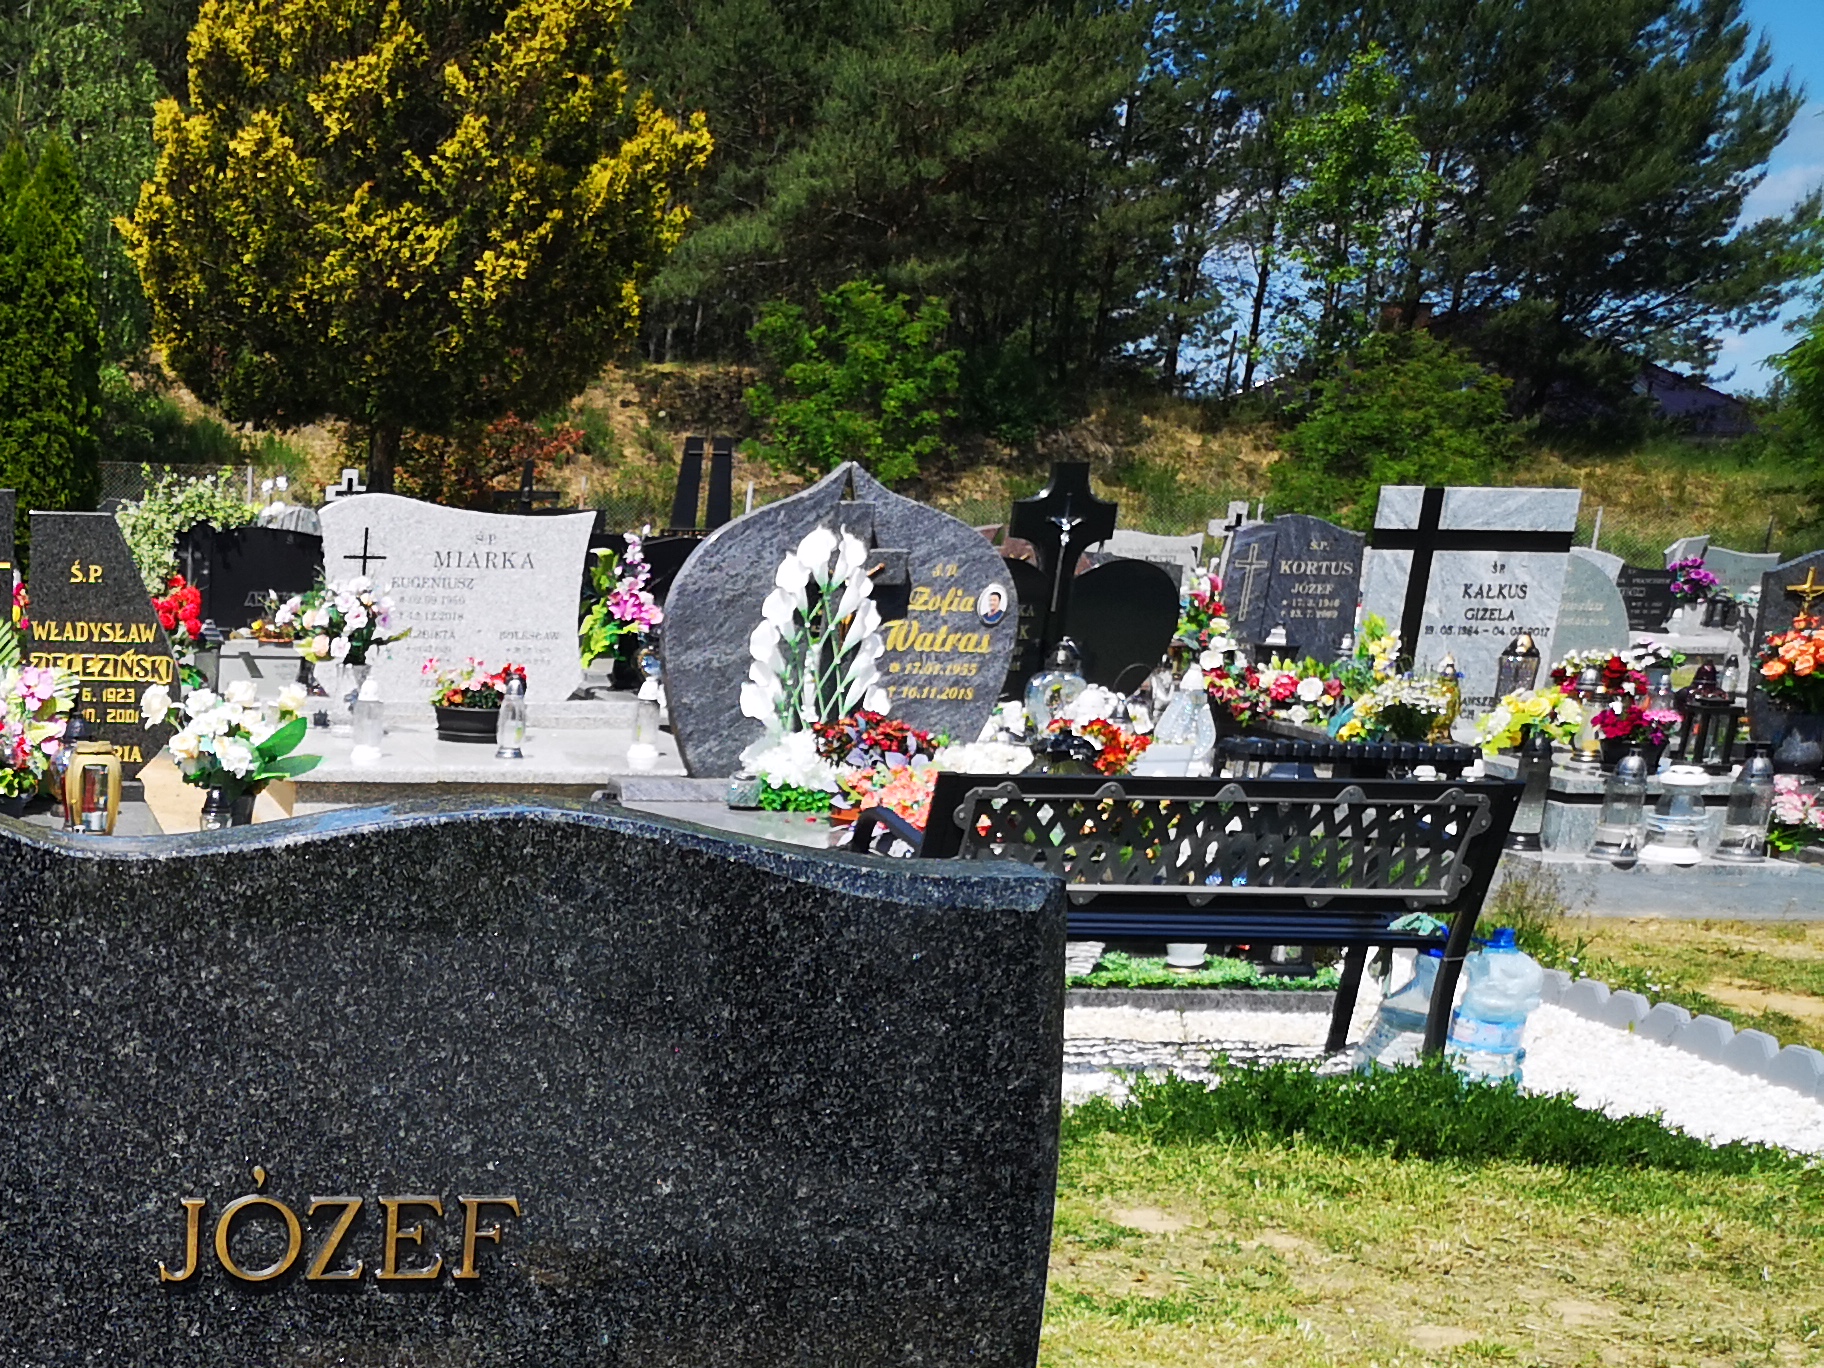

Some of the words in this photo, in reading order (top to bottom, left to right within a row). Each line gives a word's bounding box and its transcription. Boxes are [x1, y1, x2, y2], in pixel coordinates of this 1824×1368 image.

[433, 551, 536, 570] MIARKA
[1280, 559, 1354, 576] KORTUS
[70, 559, 103, 584] Ś.P.
[390, 576, 476, 591] EUGENIUSZ
[1291, 582, 1335, 596] JÓZEF
[1462, 583, 1528, 600] KAŁKUS
[908, 585, 975, 616] Zofia
[1463, 607, 1516, 623] GIZELA
[31, 620, 157, 644] WŁADYSŁAW
[881, 619, 992, 654] Watras
[154, 1165, 522, 1283] JÓZEF
